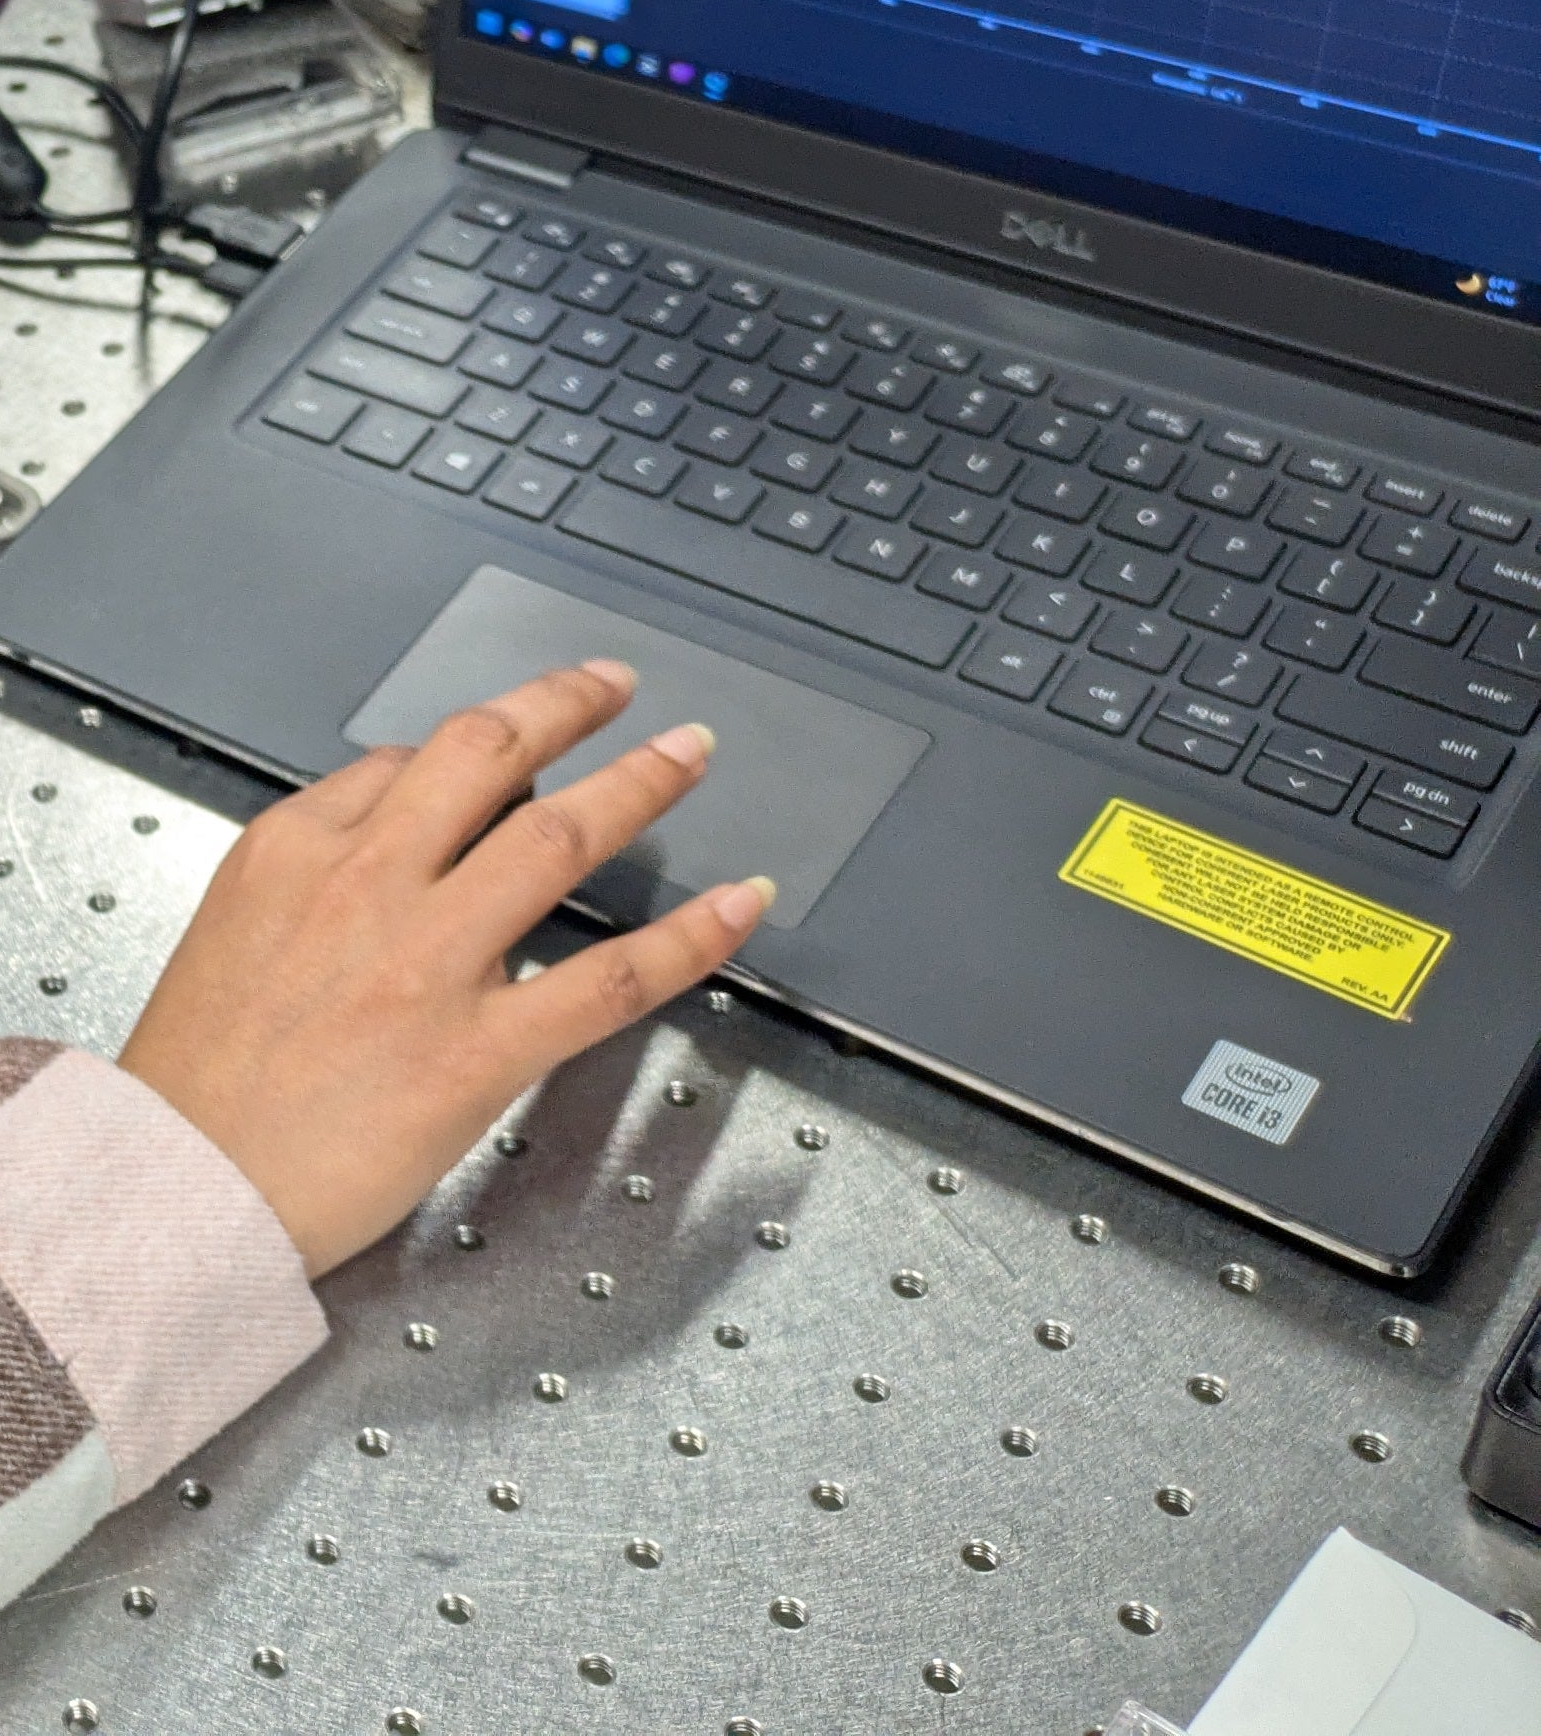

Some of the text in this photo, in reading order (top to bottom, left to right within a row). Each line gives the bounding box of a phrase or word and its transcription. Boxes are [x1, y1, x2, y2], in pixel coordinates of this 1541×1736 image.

[1468, 505, 1512, 527] delete
[1467, 682, 1512, 704] enter
[1439, 739, 1477, 761] shift
[1403, 782, 1450, 805] pg dn
[1129, 840, 1192, 870] COHERENT
[1192, 866, 1220, 882] WILL
[1222, 878, 1249, 893] NOT
[1268, 897, 1303, 916] HELD
[1302, 911, 1391, 952] RESPONSIBLE
[1144, 856, 1171, 871] FOR
[1170, 867, 1196, 881] ANY
[1196, 877, 1237, 898] LASER
[1236, 894, 1287, 919] SYSTEM
[1286, 915, 1341, 942] DAMAGE
[1153, 830, 1200, 853] LAPTOP
[1212, 854, 1274, 883] INTENDED
[1302, 891, 1355, 916] REMOTE
[1355, 912, 1416, 941] CONTROL
[1167, 846, 1194, 861] FOR
[1194, 857, 1258, 887] COHERENT
[1258, 883, 1301, 905] LASER
[1300, 900, 1369, 933] PRODUCTS
[1149, 868, 1207, 896] CONTROL
[1205, 892, 1274, 924] CONFLICTS
[1274, 920, 1326, 946] CAUSED
[1155, 891, 1224, 924] HARDWARE
[1255, 922, 1322, 955] APPROVED
[1234, 1062, 1283, 1092] intel
[1201, 1082, 1282, 1129] CORE i3
